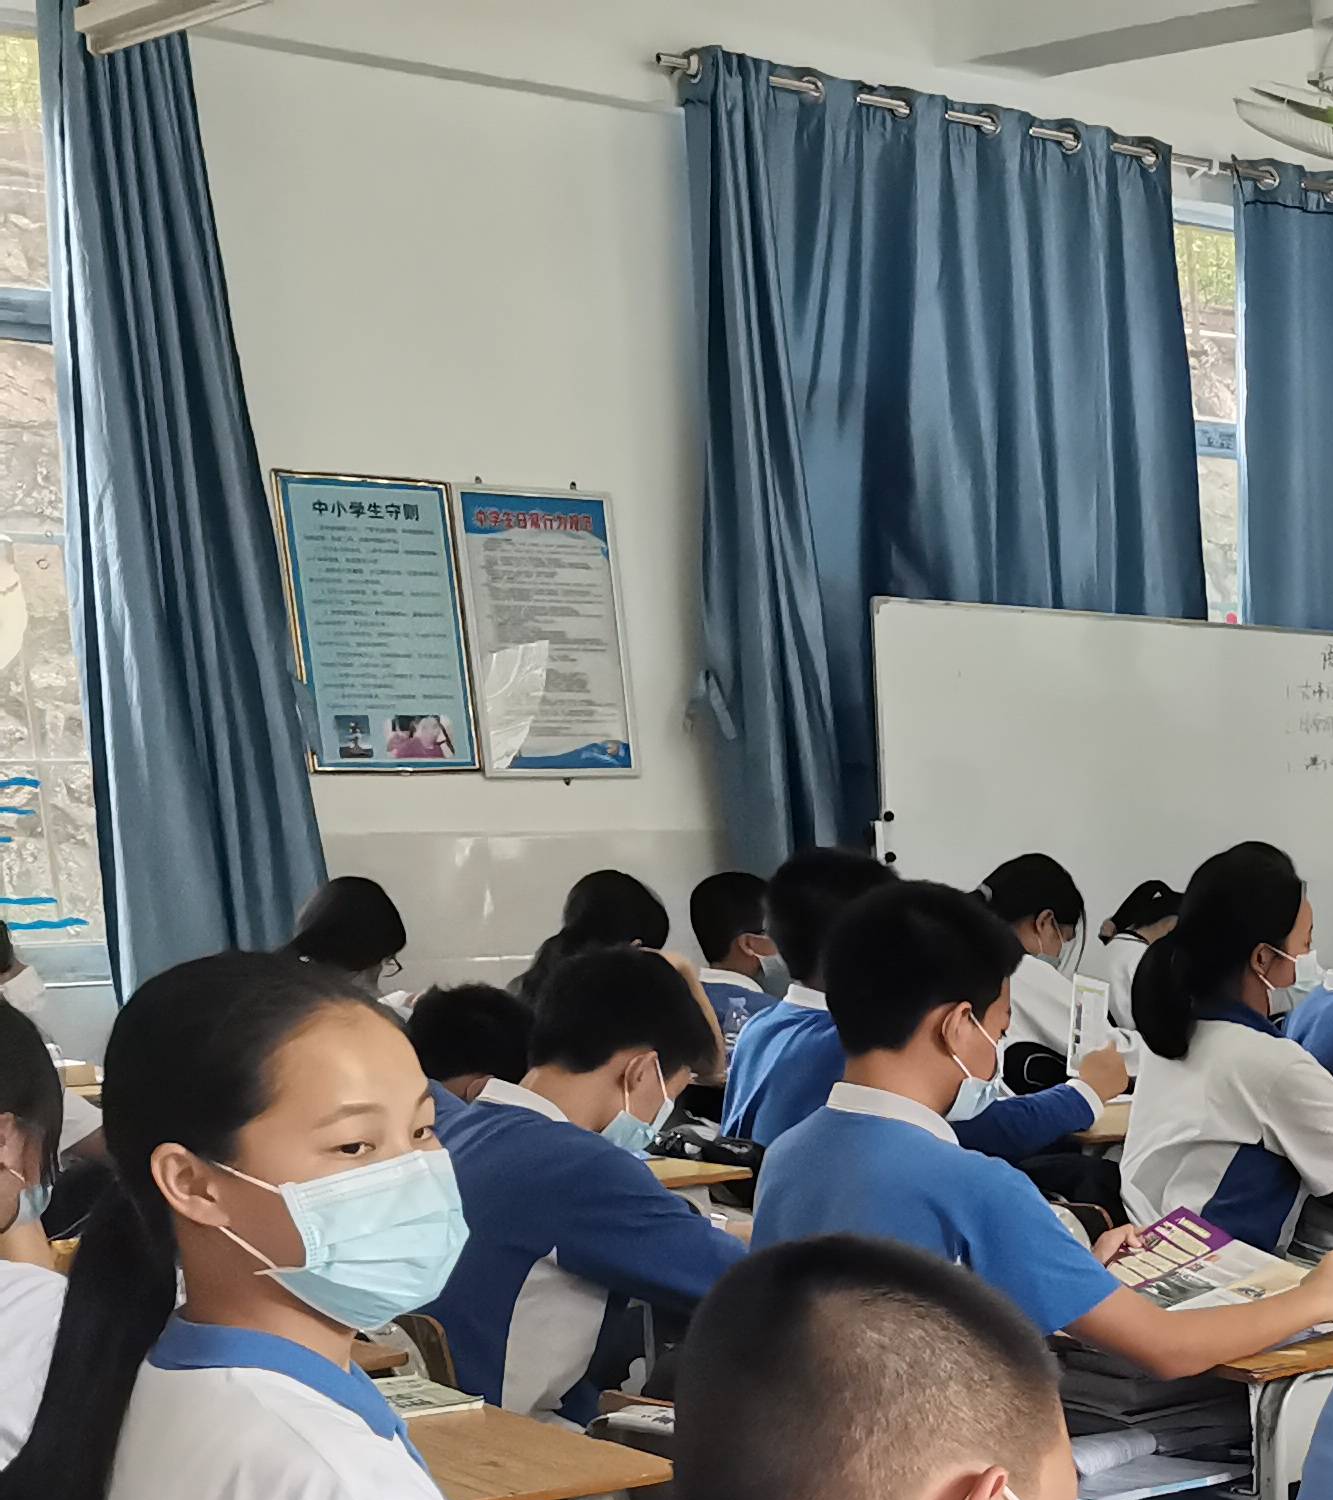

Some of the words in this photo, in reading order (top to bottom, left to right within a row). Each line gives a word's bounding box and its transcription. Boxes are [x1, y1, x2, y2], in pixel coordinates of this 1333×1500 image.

[312, 499, 419, 521] 中小学生守则
